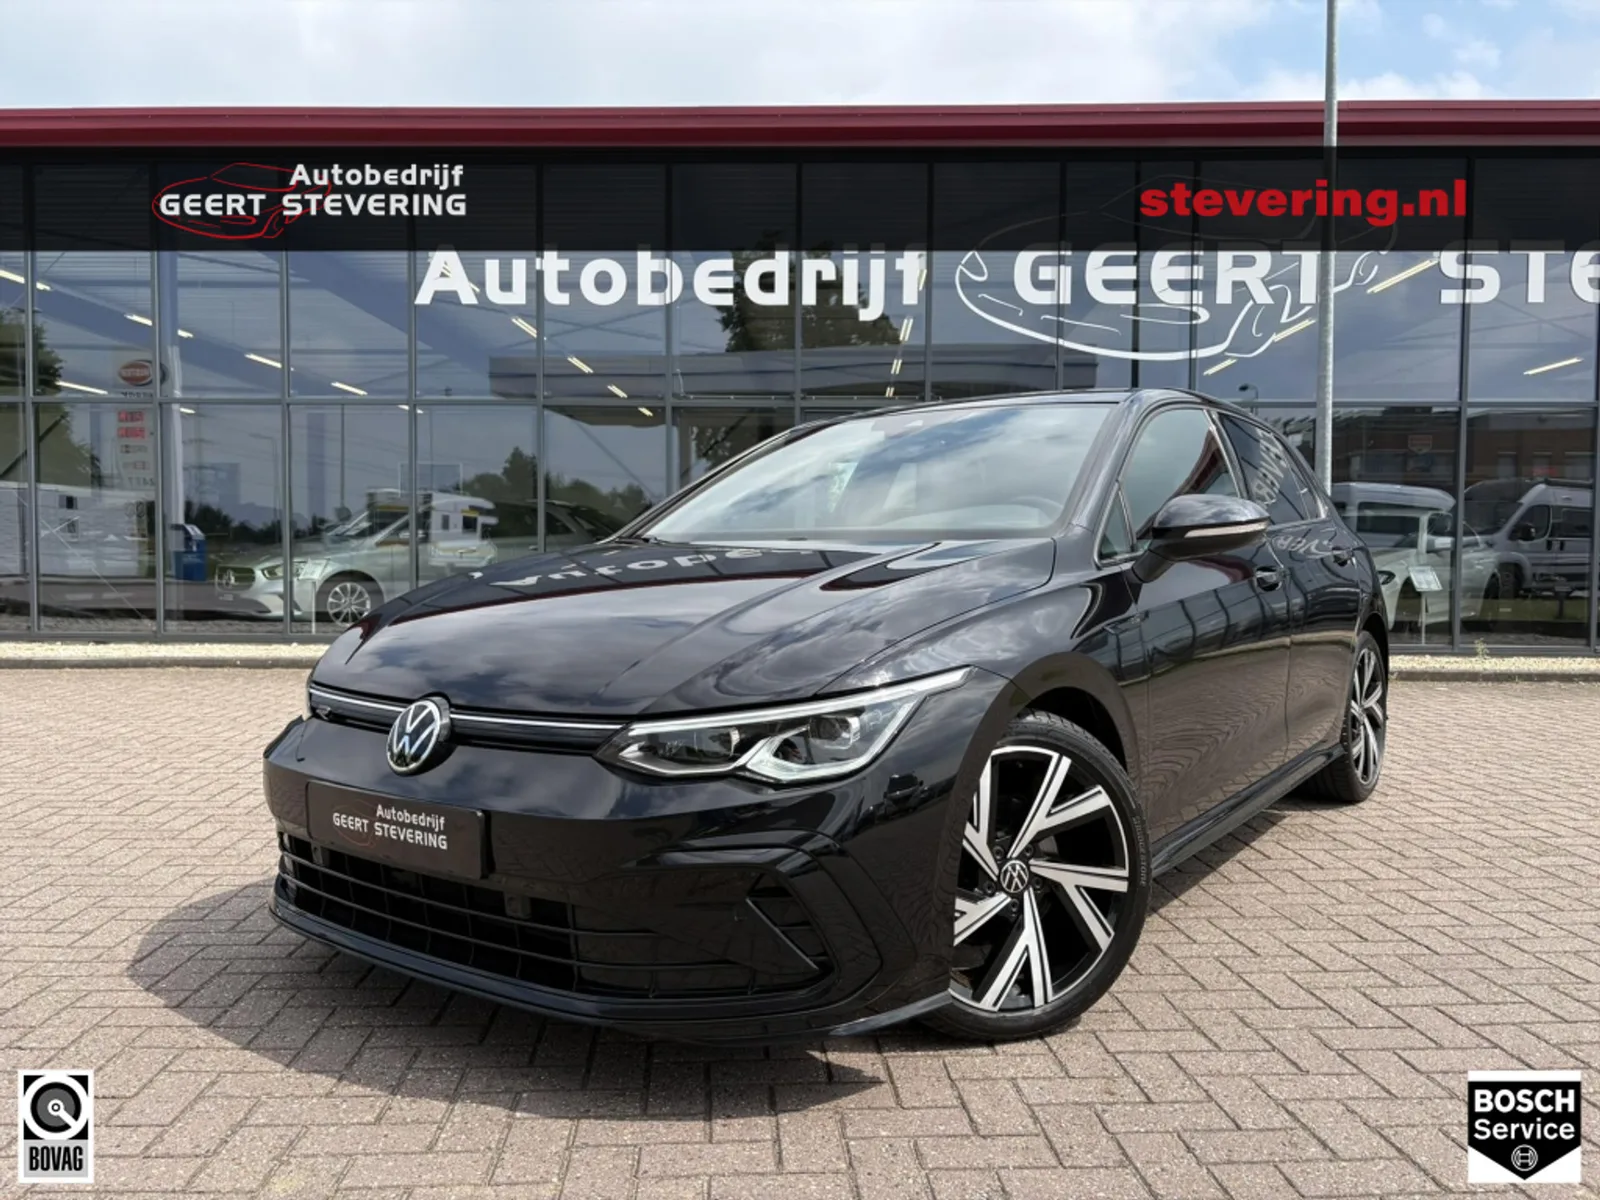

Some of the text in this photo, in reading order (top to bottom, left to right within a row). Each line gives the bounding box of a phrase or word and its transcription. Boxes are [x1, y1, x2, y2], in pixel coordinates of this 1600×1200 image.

[414, 246, 927, 322] Autobedrijf
[1013, 245, 1321, 304] GEERT
[332, 812, 448, 850] GEERT STEVERING
[376, 804, 445, 832] Autobedrijf
